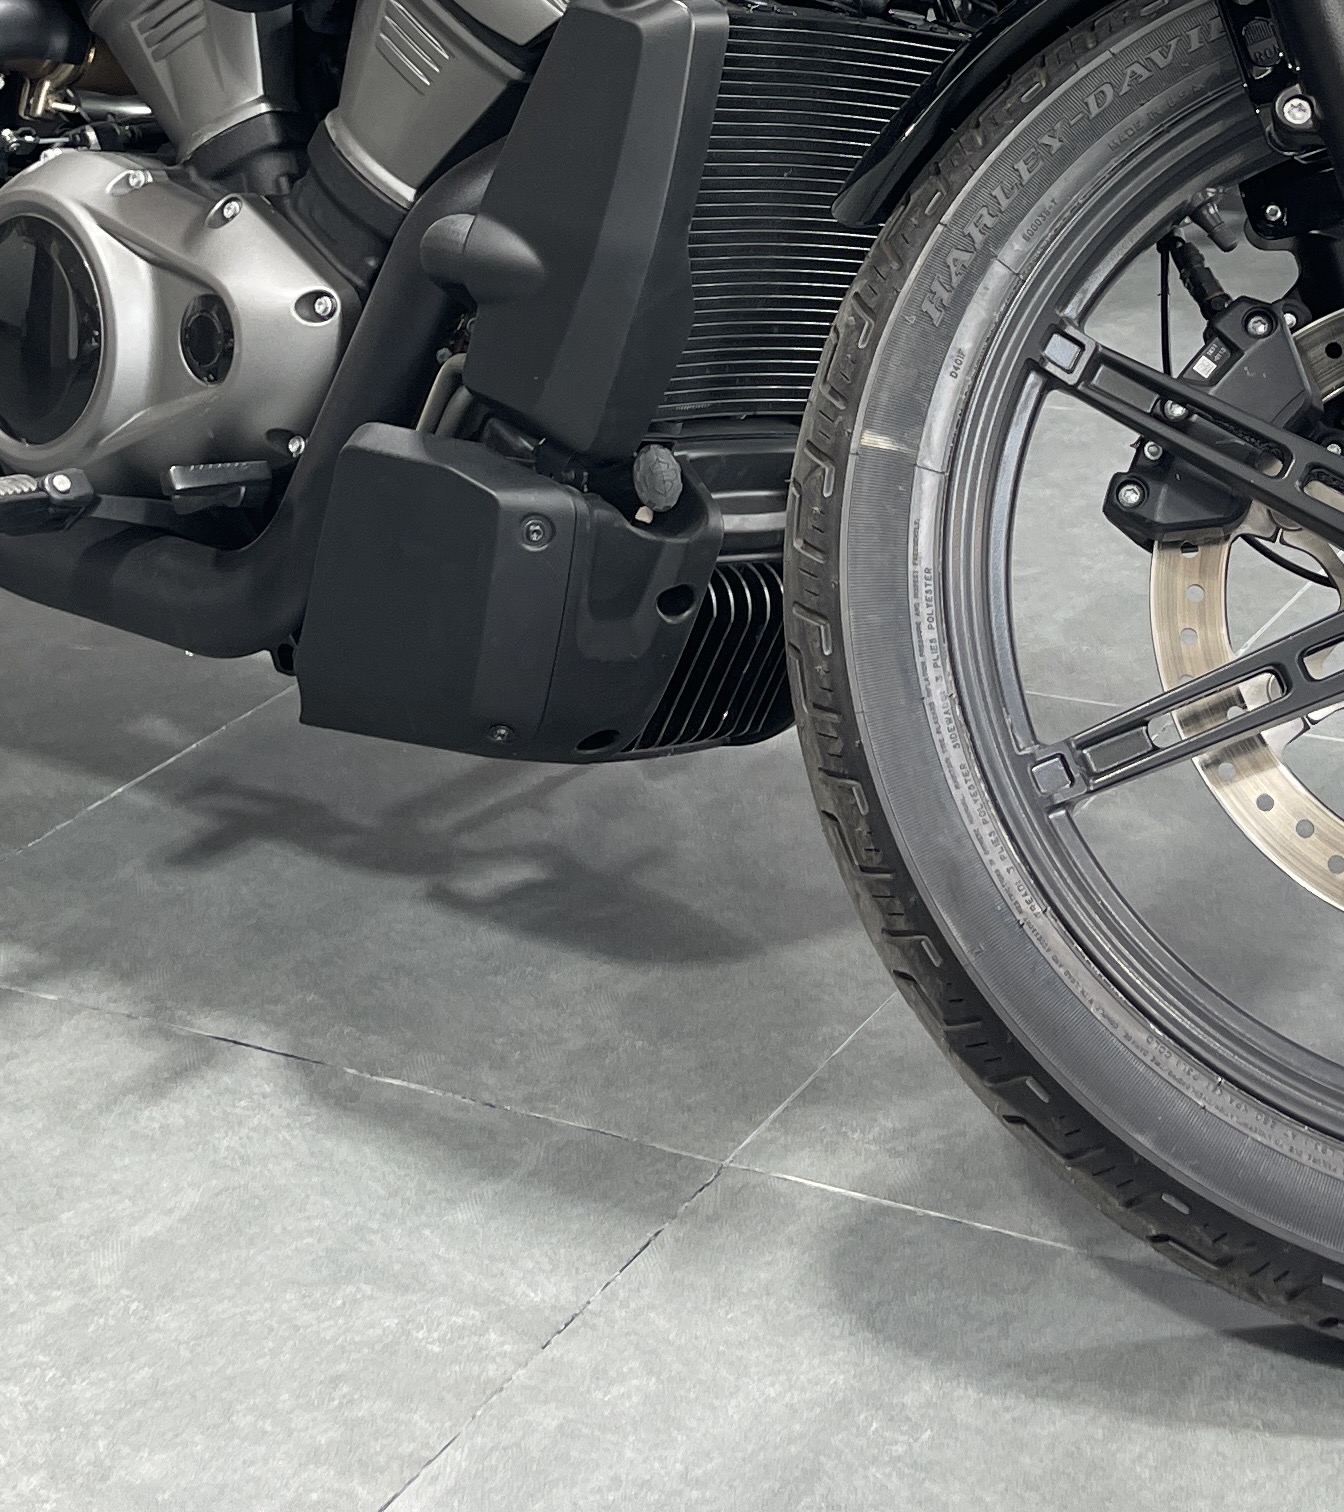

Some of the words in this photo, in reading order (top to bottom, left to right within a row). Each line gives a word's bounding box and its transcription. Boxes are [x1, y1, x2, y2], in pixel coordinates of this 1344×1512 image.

[1106, 118, 1145, 152] MADE
[947, 346, 968, 379] D401F
[923, 566, 935, 631] POLYESTER
[927, 637, 940, 669] PLIES
[957, 761, 990, 826] POLYESTER
[986, 829, 1009, 862] PLIES
